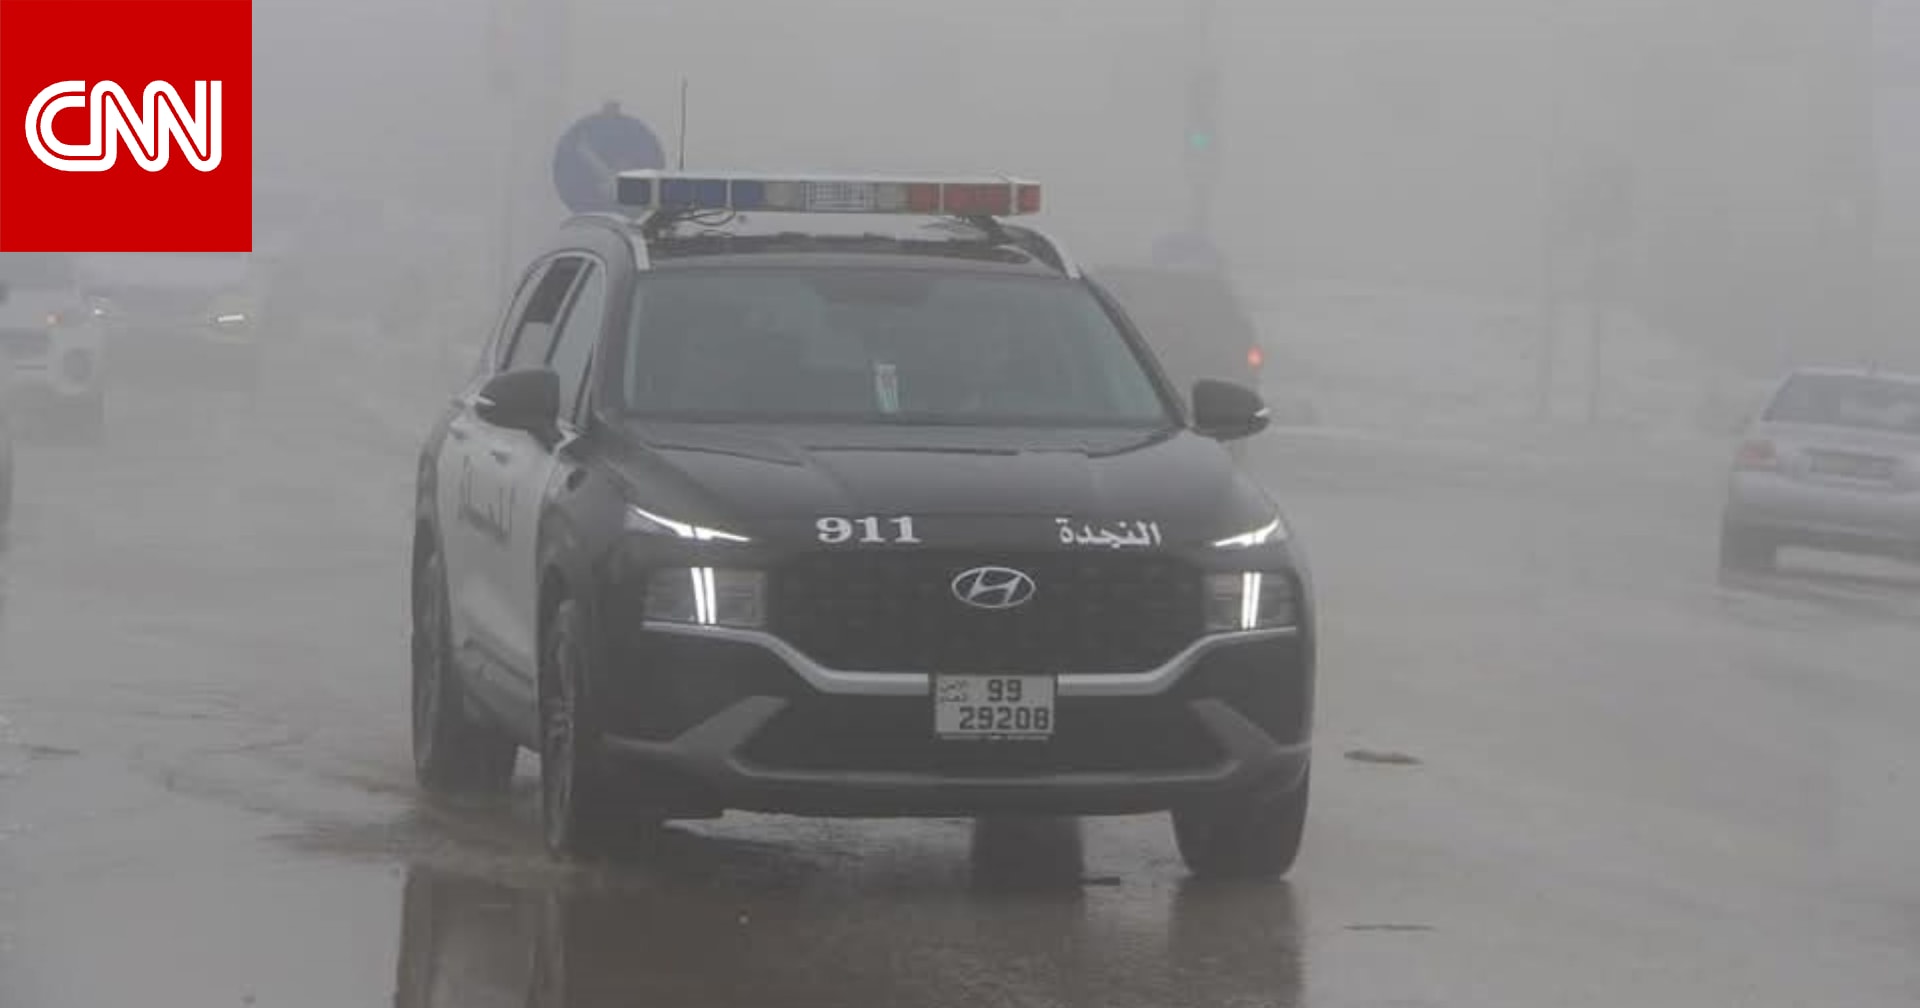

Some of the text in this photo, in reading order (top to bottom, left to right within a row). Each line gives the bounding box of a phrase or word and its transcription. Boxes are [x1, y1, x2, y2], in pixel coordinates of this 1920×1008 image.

[815, 515, 921, 543] 911
[1055, 517, 1162, 548] النجدة
[988, 679, 1022, 702] 99
[960, 706, 1049, 730] 29208
